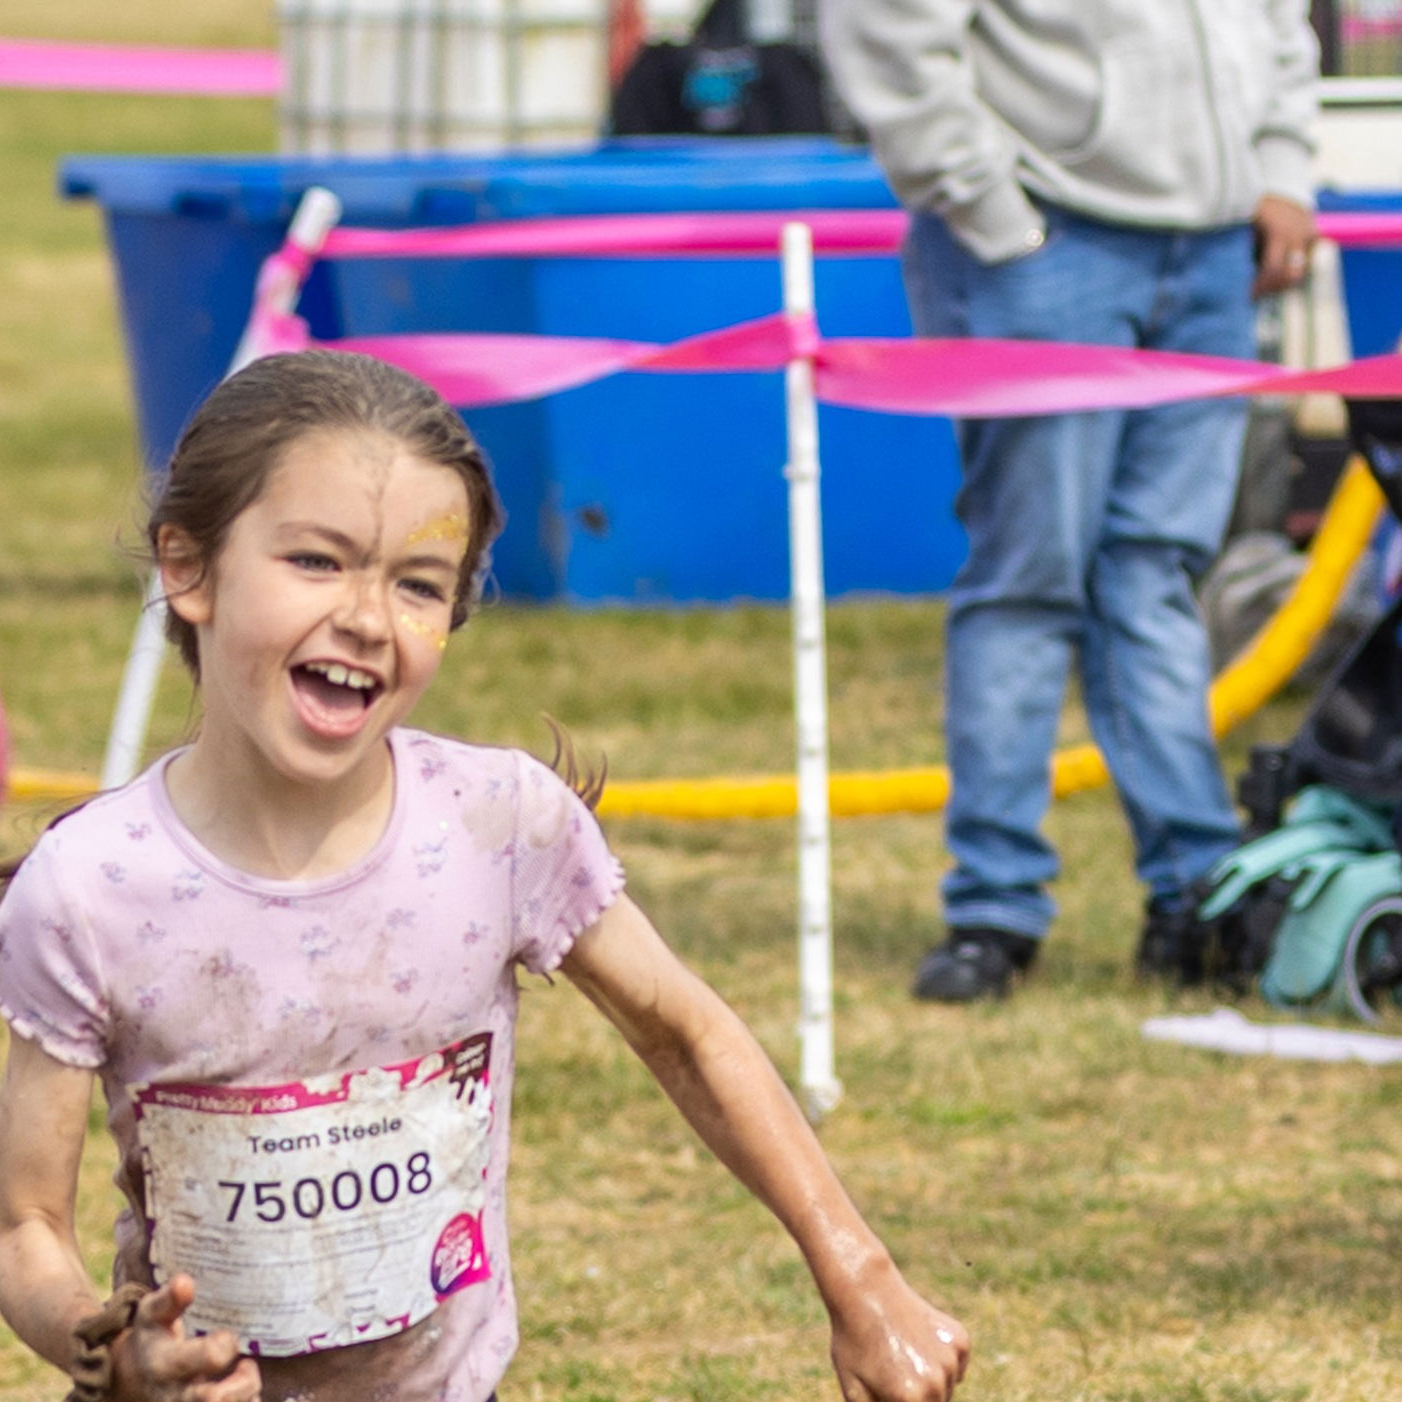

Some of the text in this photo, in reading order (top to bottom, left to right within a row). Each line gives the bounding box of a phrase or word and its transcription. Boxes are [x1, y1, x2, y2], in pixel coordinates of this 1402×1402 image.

[260, 1093, 297, 1112] Kids
[248, 1117, 402, 1154] Team Steele
[218, 1151, 432, 1223] 750008
